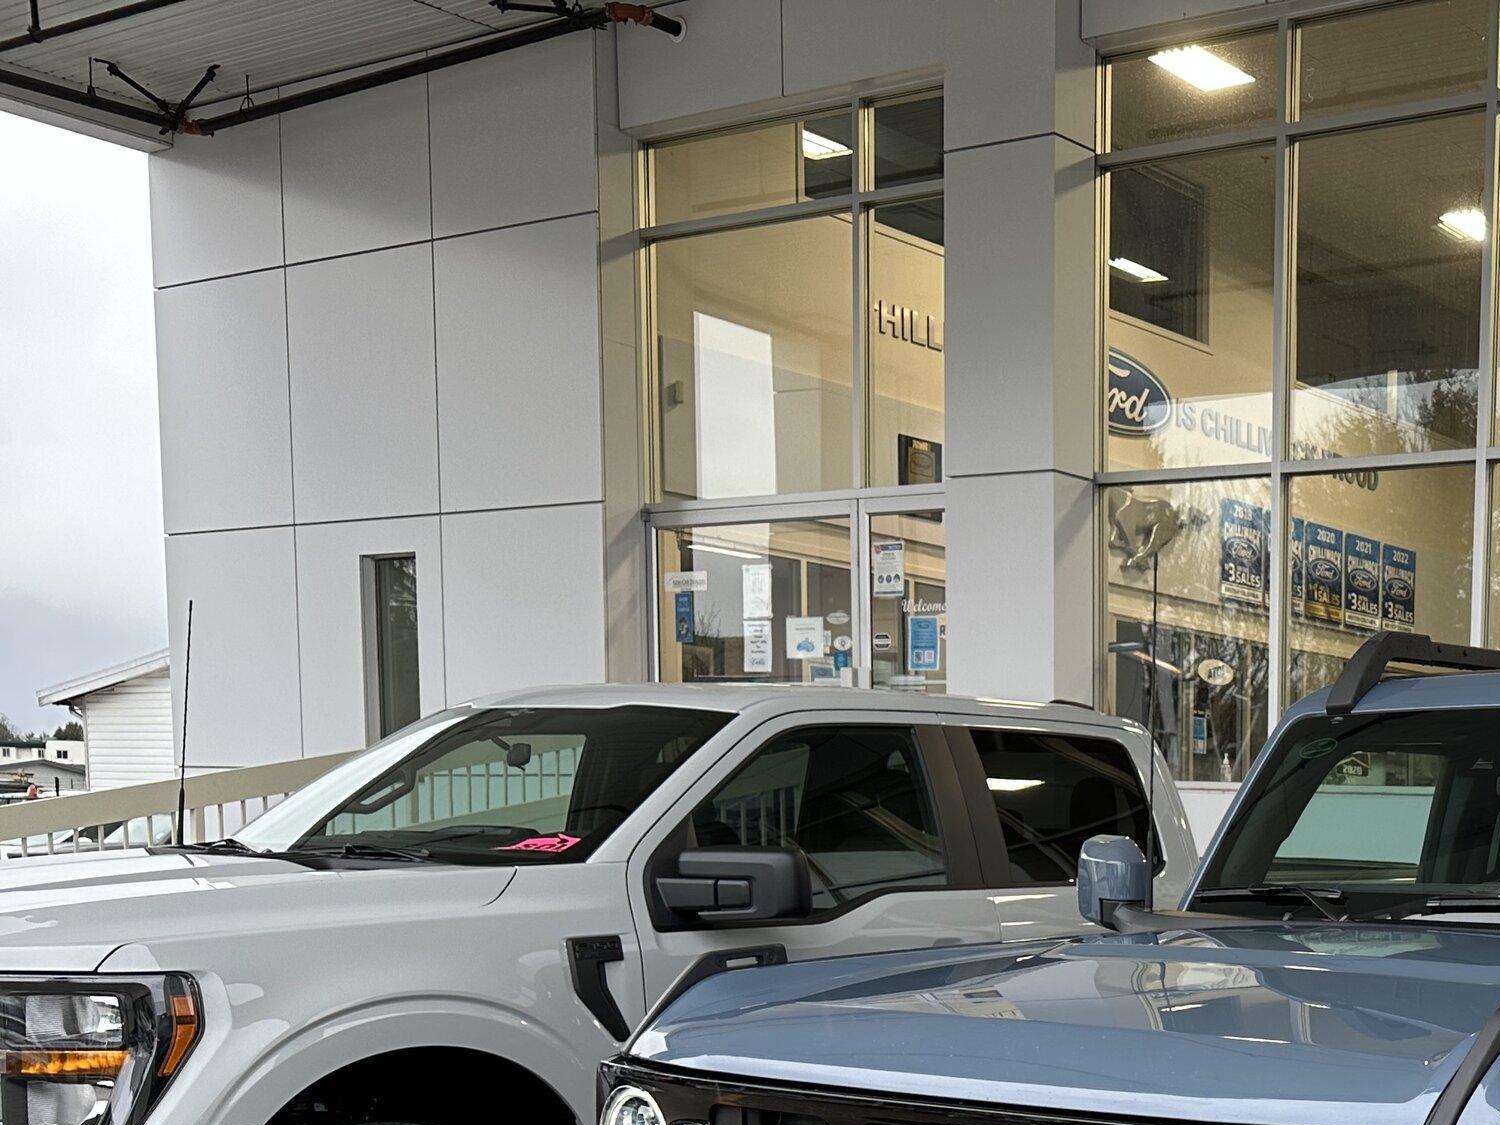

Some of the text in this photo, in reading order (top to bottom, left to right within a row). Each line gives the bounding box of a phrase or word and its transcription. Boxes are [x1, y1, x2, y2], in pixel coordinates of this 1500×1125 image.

[1316, 528, 1336, 544] 2020
[1355, 539, 1372, 555] 2021
[1392, 550, 1409, 565] 2022
[1235, 572, 1261, 587] SALES
[1357, 601, 1378, 615] SALES
[1393, 609, 1414, 622] SALES
